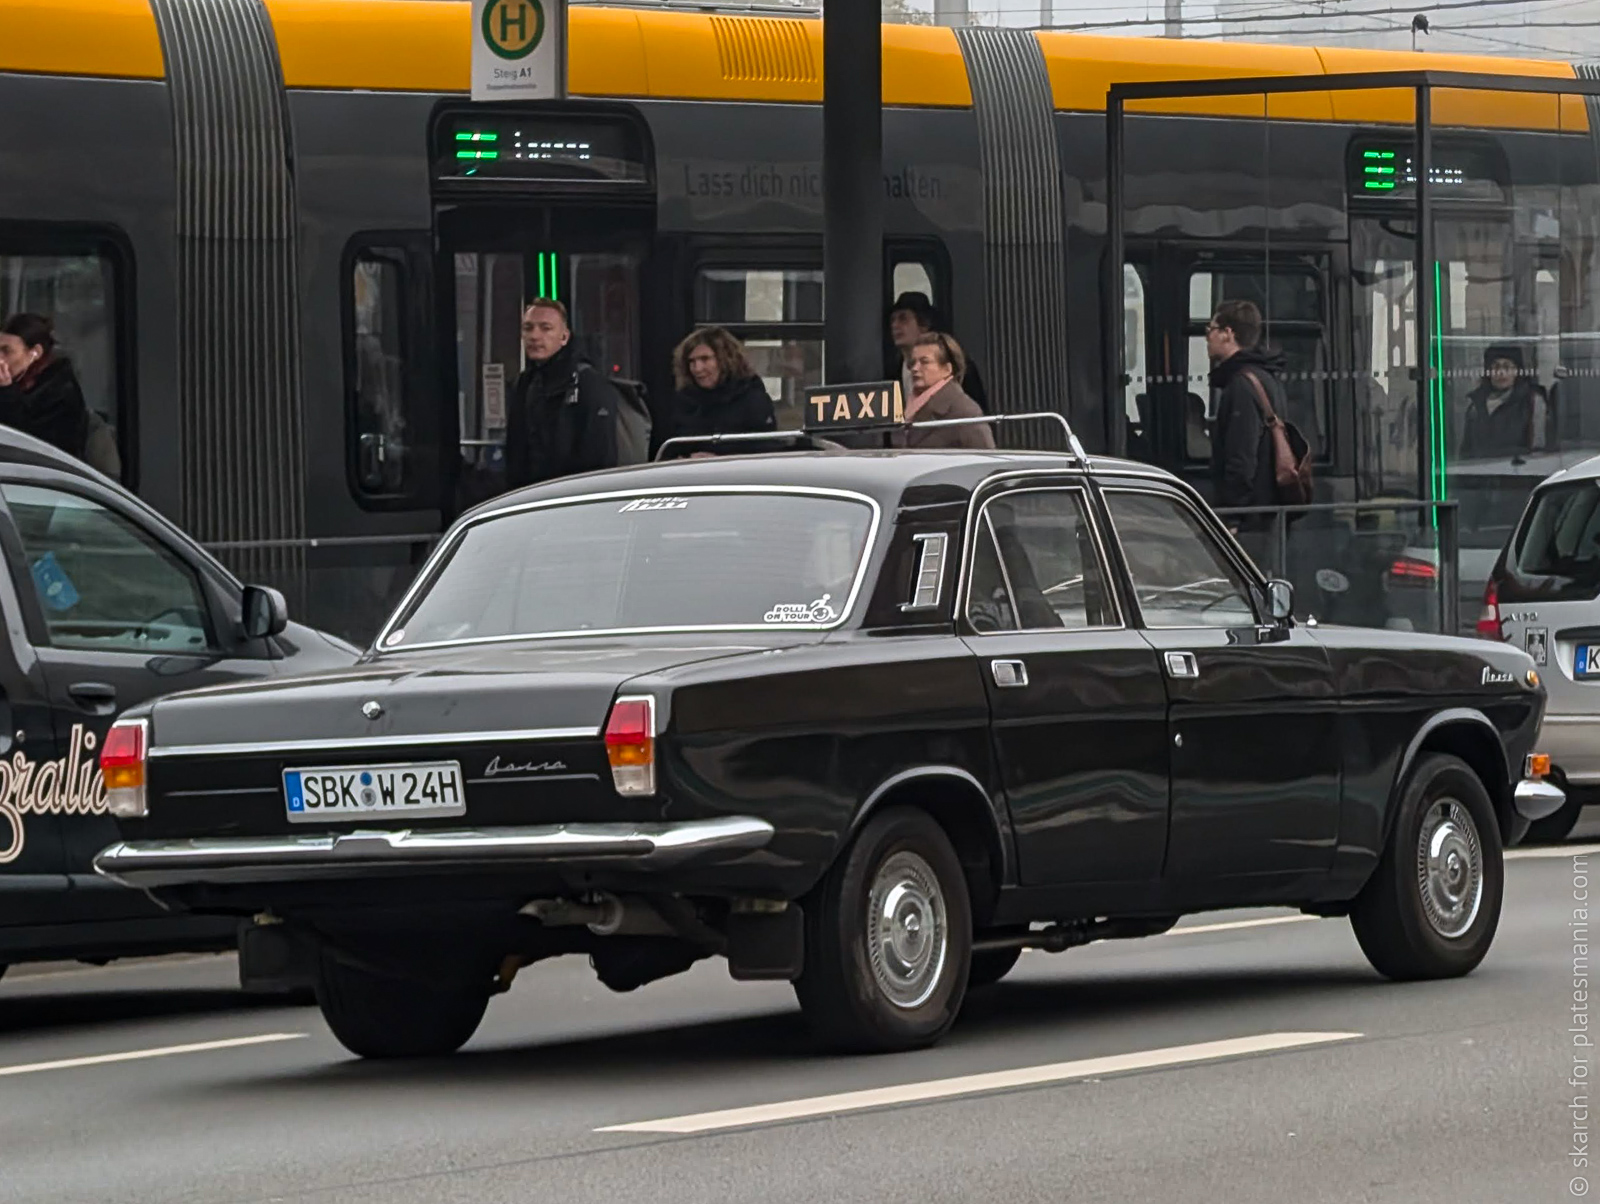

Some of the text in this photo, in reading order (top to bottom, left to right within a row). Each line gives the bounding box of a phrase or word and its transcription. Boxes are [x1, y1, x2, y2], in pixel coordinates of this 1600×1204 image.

[500, 4, 526, 41] H
[494, 67, 532, 80] Steig A1
[684, 164, 734, 197] Lass
[740, 164, 784, 198] dich
[789, 164, 824, 198] nic
[810, 391, 889, 422] TAXI
[304, 770, 459, 808] SBK W 24H
